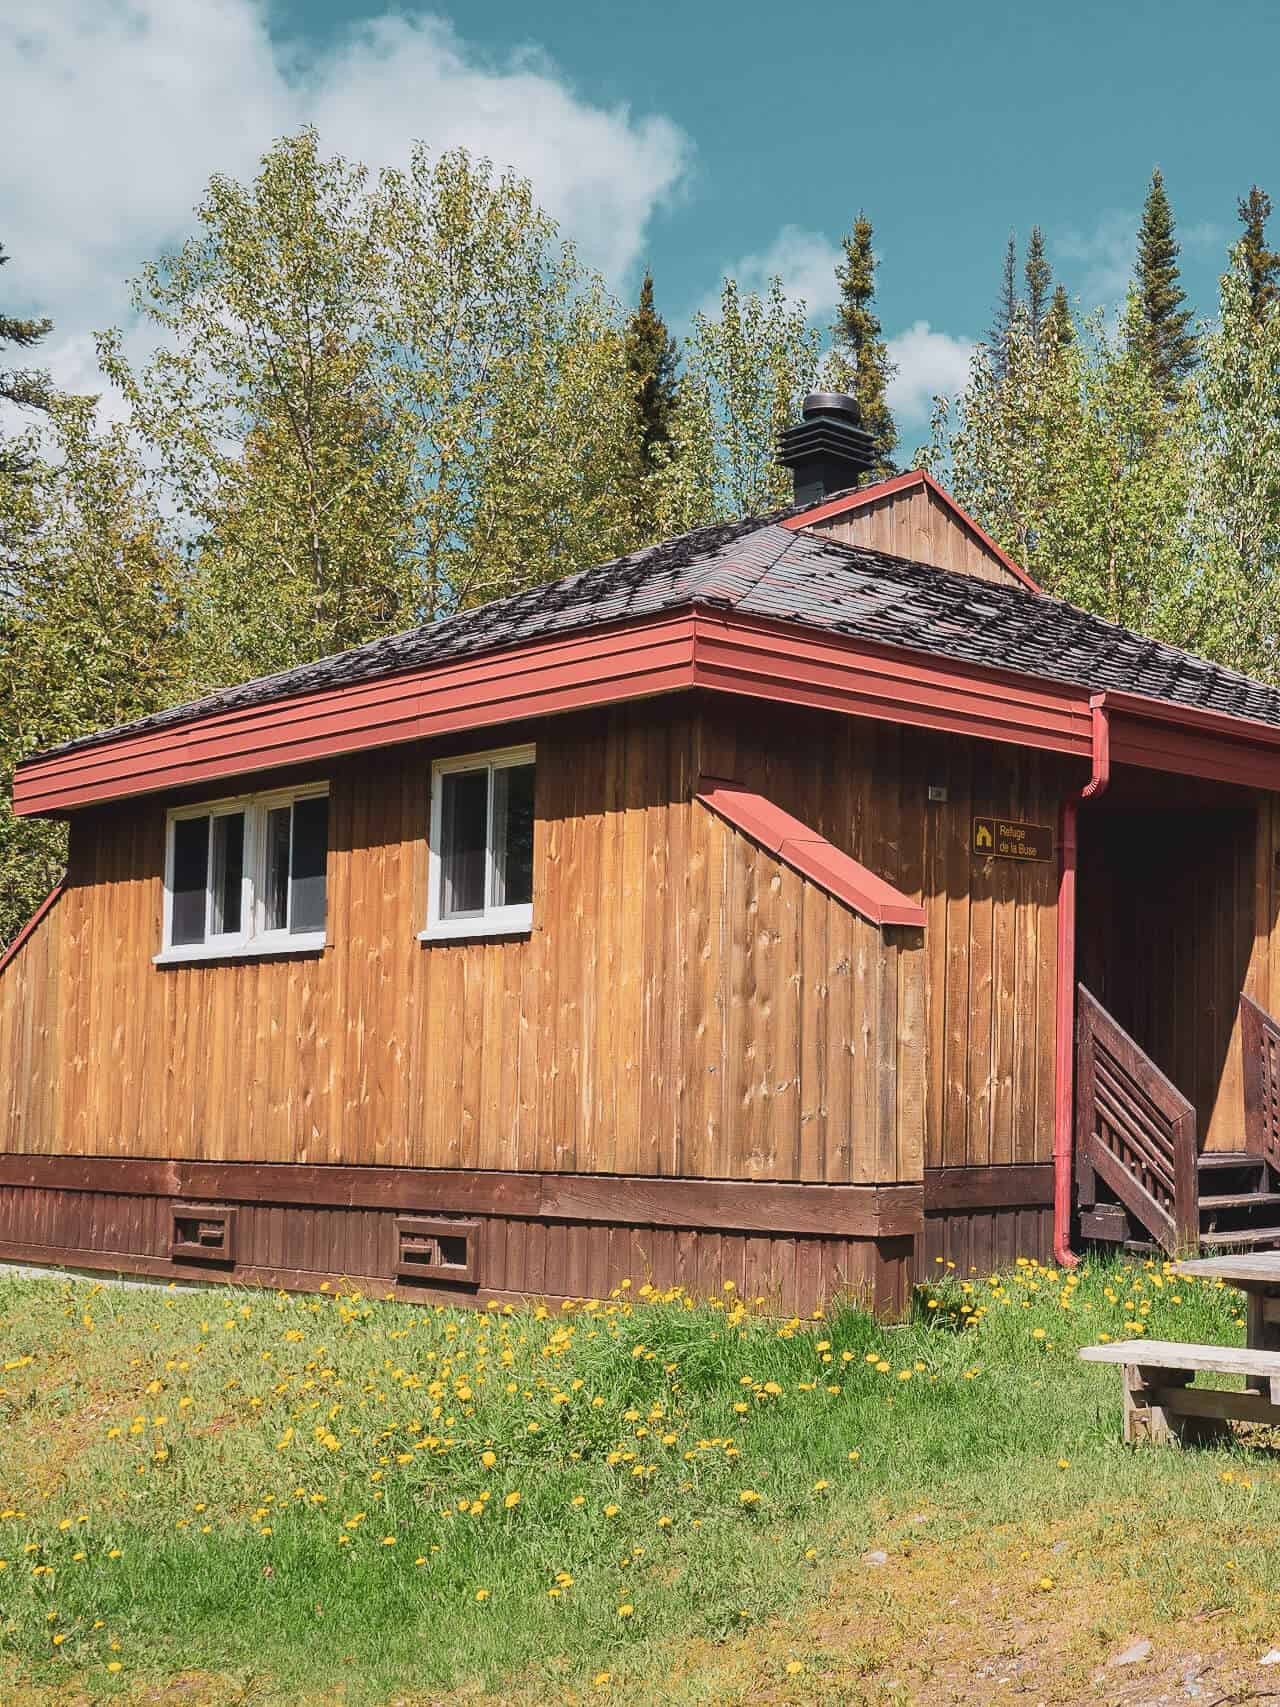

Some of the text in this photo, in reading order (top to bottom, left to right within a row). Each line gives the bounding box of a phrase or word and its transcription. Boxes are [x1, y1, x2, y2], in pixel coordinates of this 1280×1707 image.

[1000, 825, 1025, 840] Refuge
[1000, 841, 1009, 852] de
[1010, 842, 1018, 854] la
